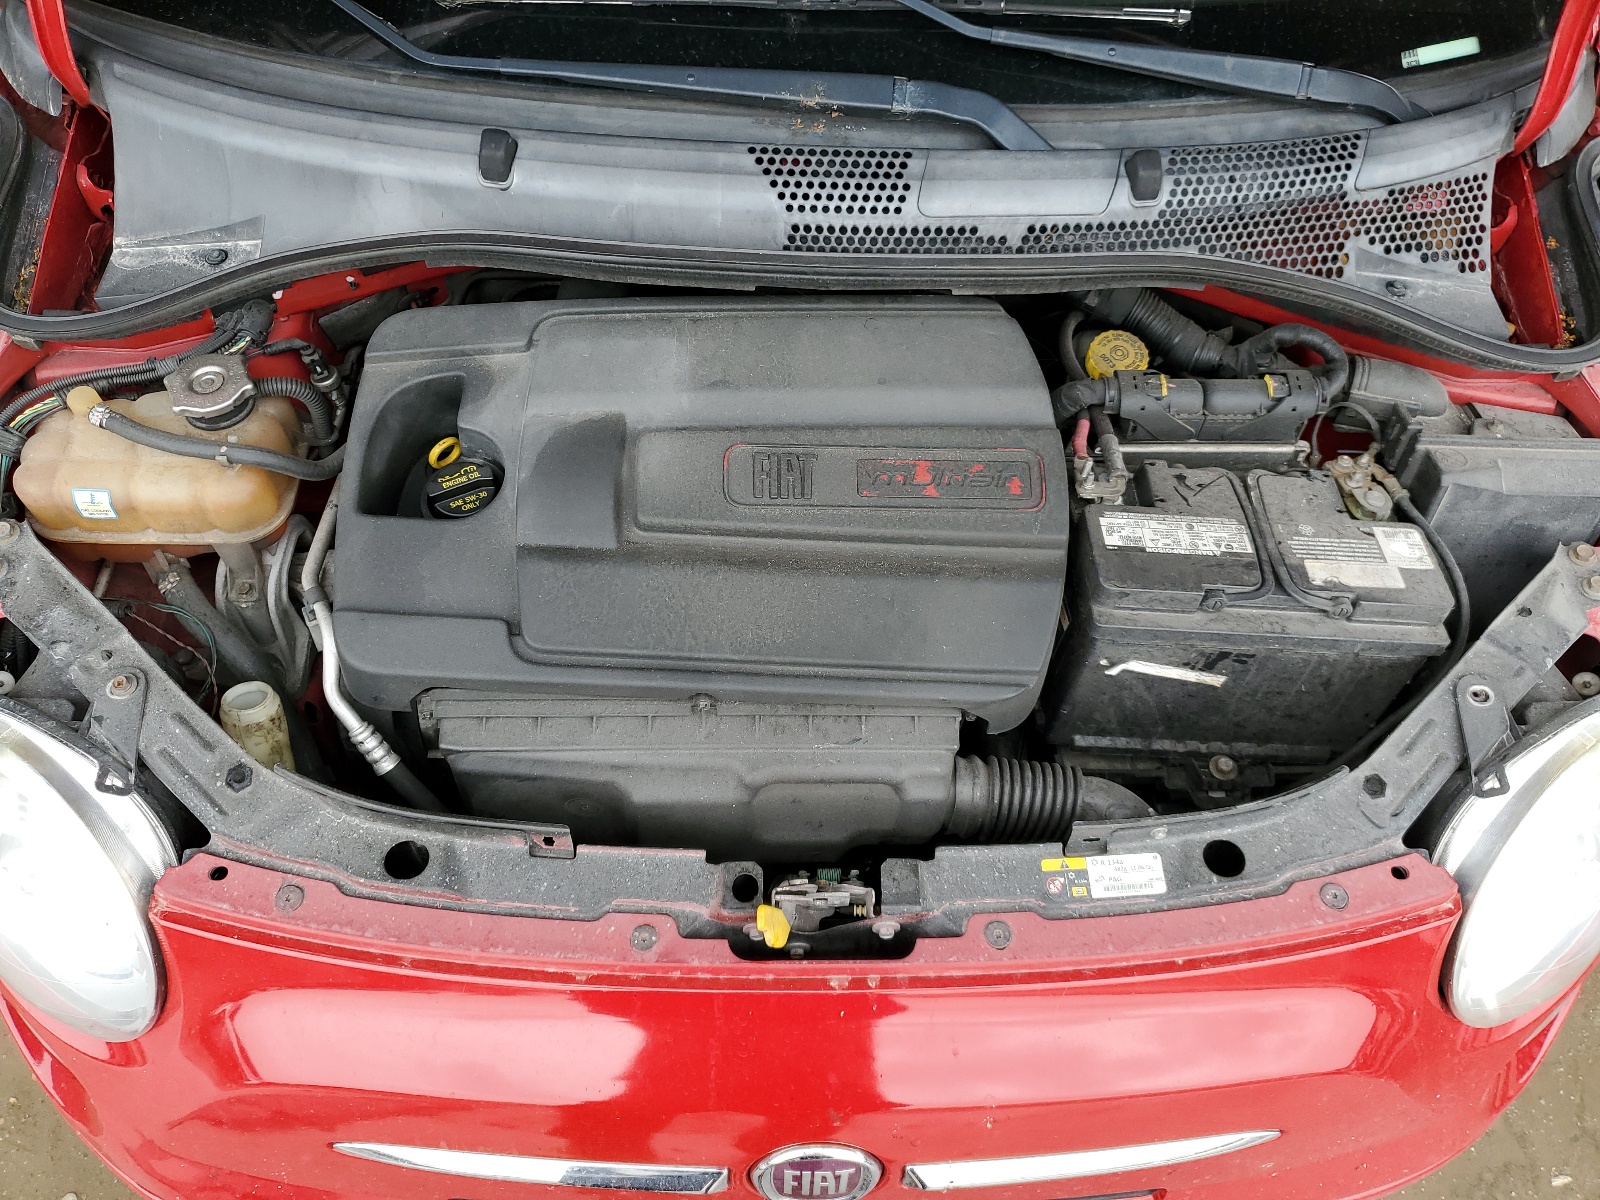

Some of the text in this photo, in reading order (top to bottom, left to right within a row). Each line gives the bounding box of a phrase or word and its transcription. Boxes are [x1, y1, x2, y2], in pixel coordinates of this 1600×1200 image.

[442, 471, 481, 489] ENGINE OIL
[753, 452, 818, 499] FIAT
[449, 491, 487, 508] SAE 5W-30
[461, 500, 480, 511] ONLY
[783, 1168, 856, 1196] FIAT
